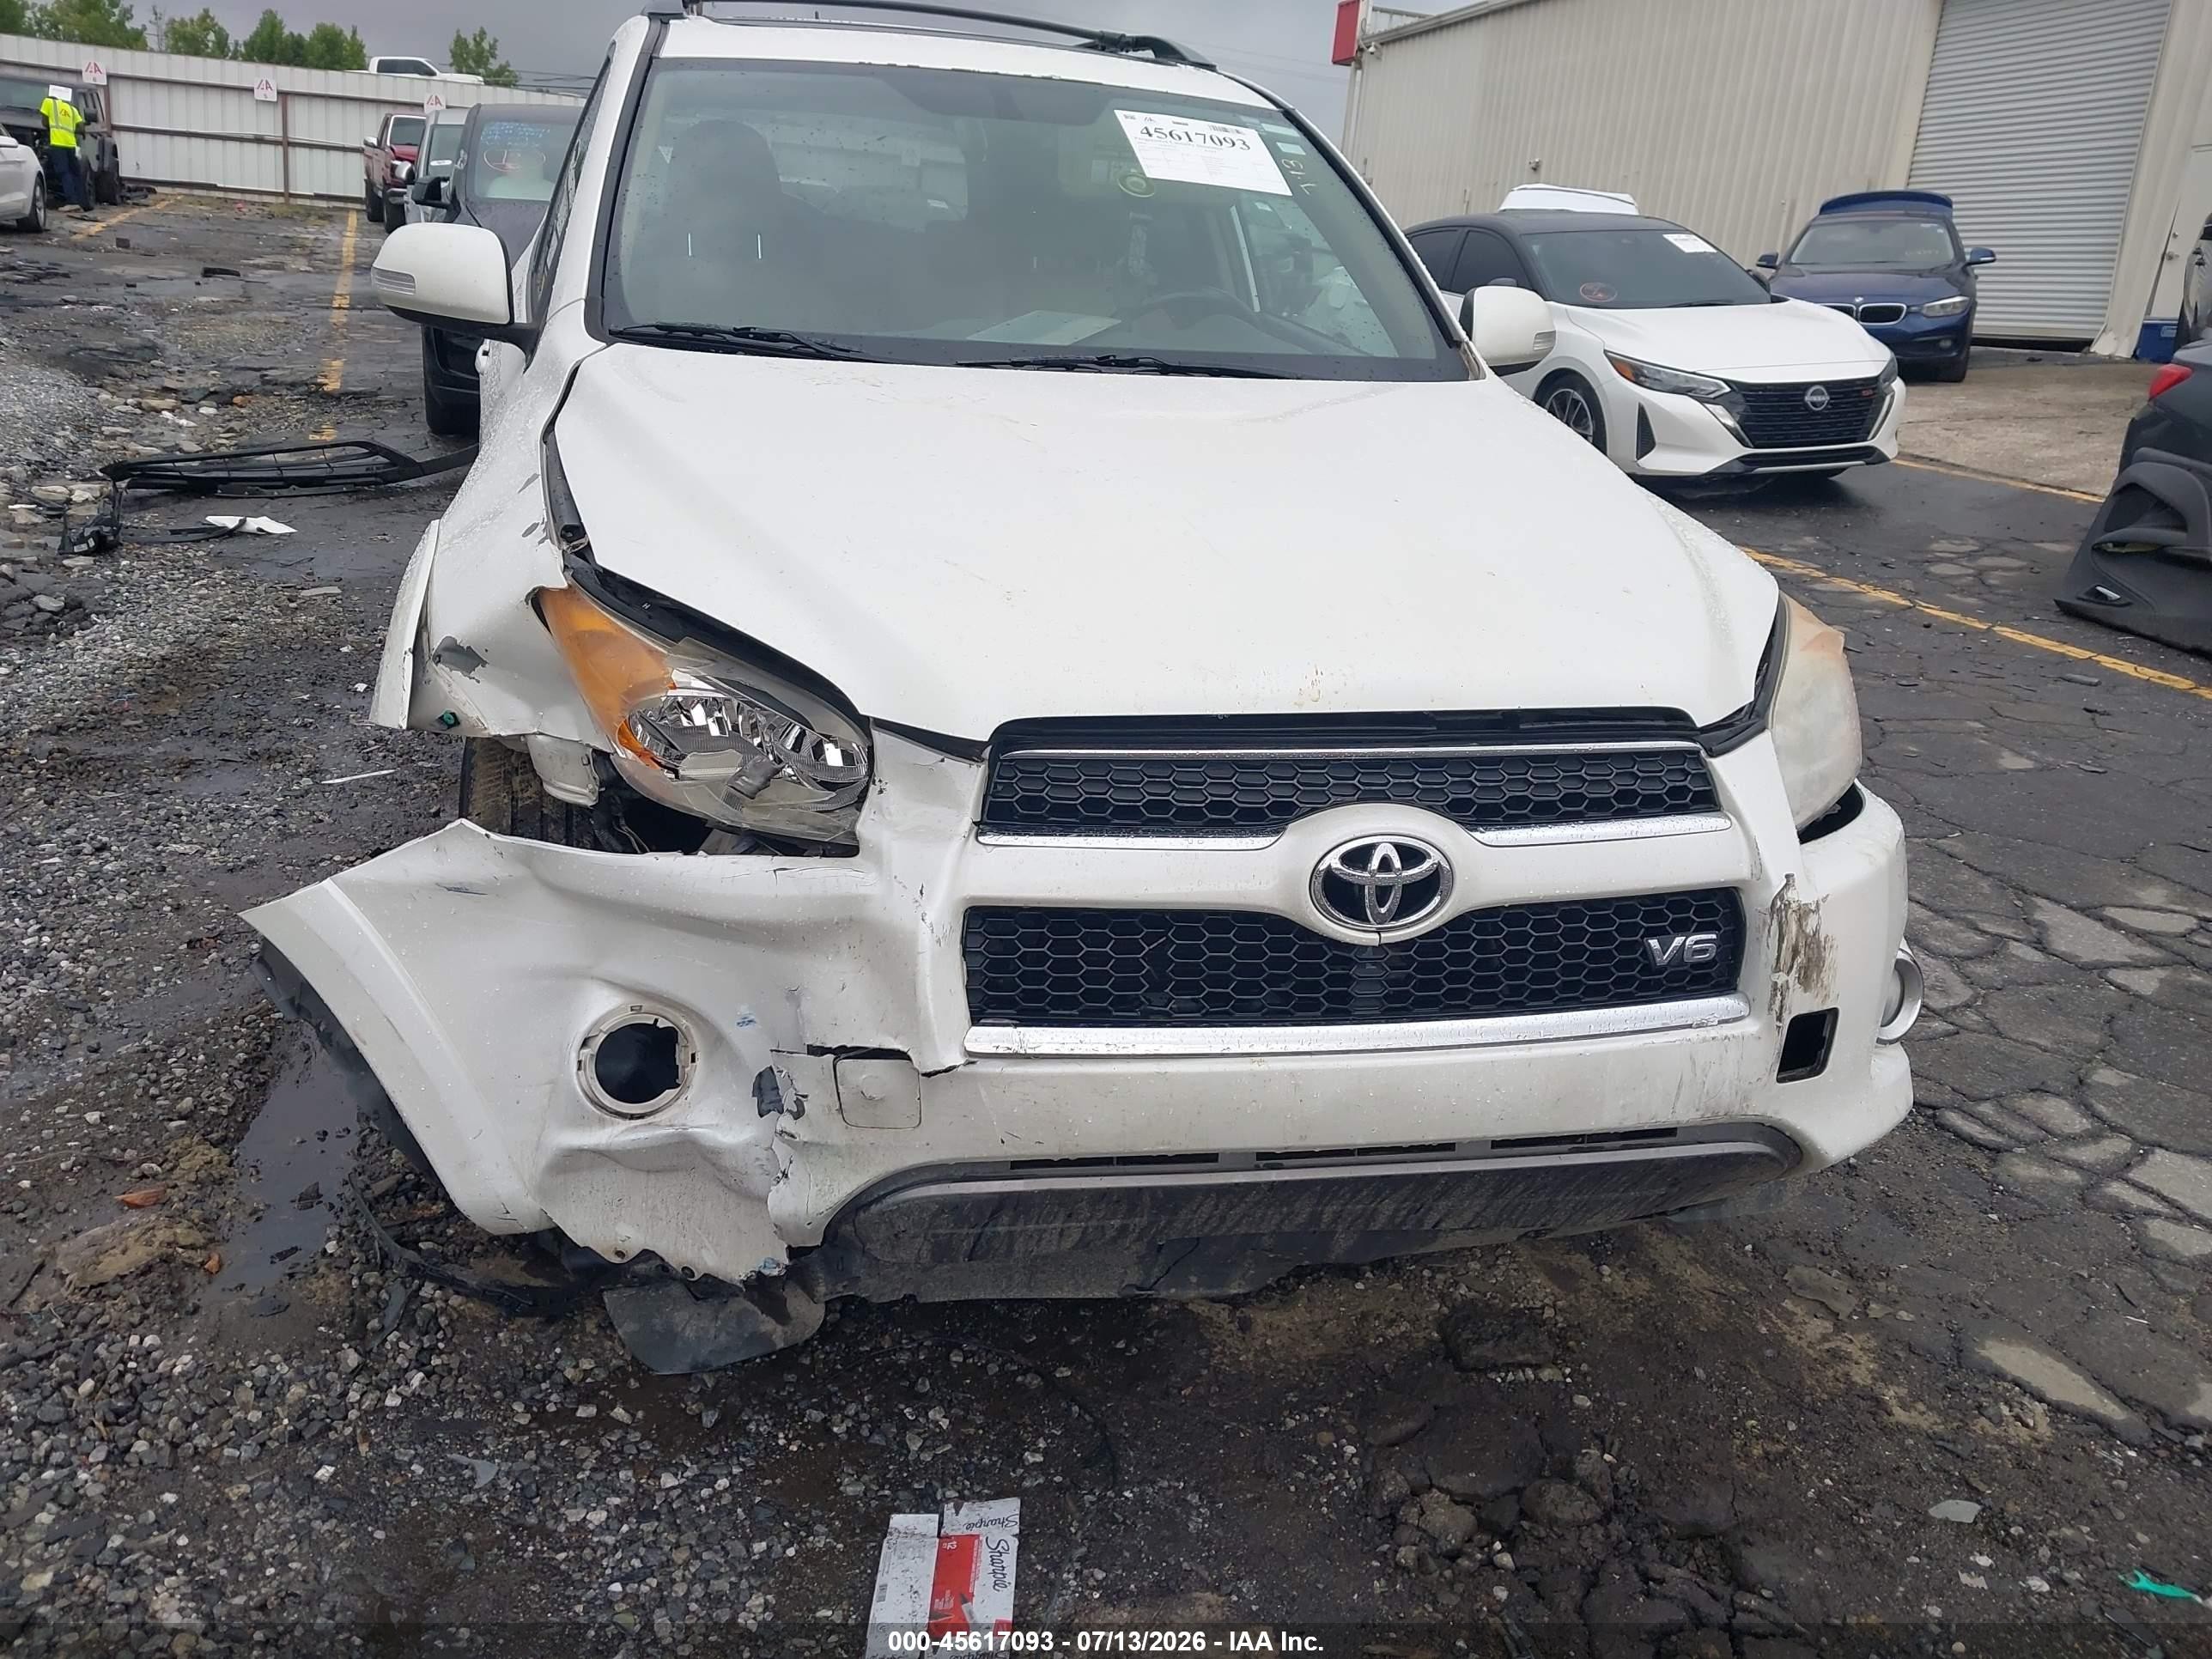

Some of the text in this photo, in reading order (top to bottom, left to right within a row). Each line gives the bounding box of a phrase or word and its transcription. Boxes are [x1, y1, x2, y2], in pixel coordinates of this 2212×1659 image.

[1139, 125, 1251, 151] 45617093
[1647, 933, 1718, 967] V6
[963, 1513, 1019, 1531] Sharpie
[947, 1540, 957, 1551] 12
[985, 1535, 1012, 1592] Sharpie
